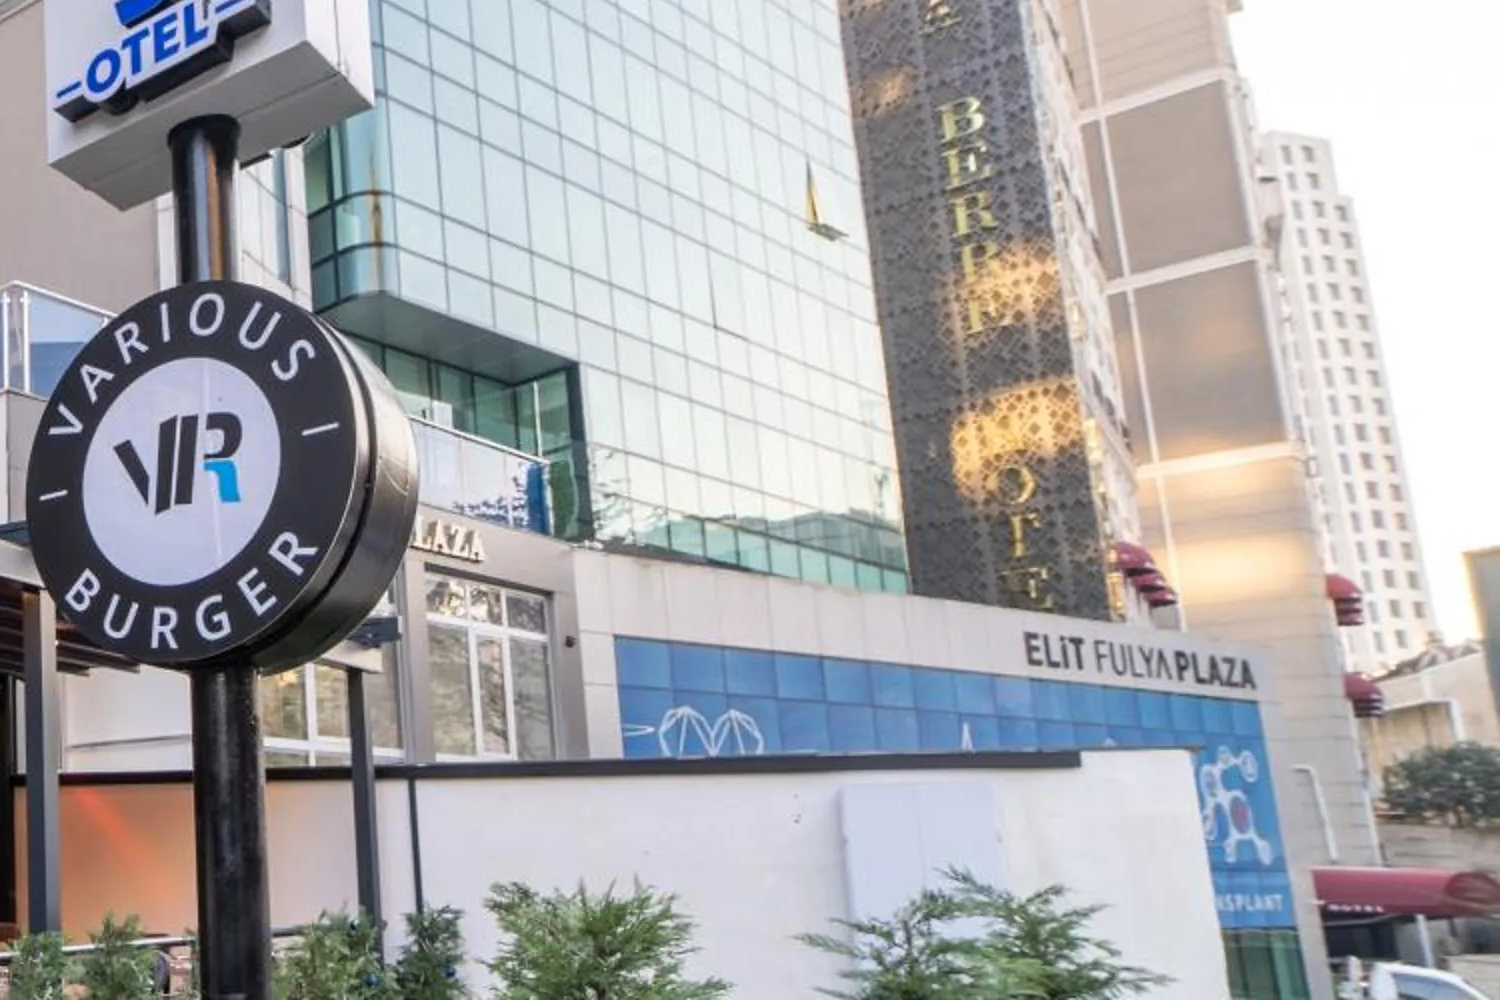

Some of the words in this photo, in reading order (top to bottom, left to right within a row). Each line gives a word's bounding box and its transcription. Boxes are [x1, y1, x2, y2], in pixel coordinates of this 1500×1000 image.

[86, 2, 209, 93] OTEL
[49, 292, 315, 437] VARIOUS
[65, 530, 319, 650] BURGER
[1094, 640, 1172, 680] FULYA
[1175, 650, 1257, 690] PLAZA
